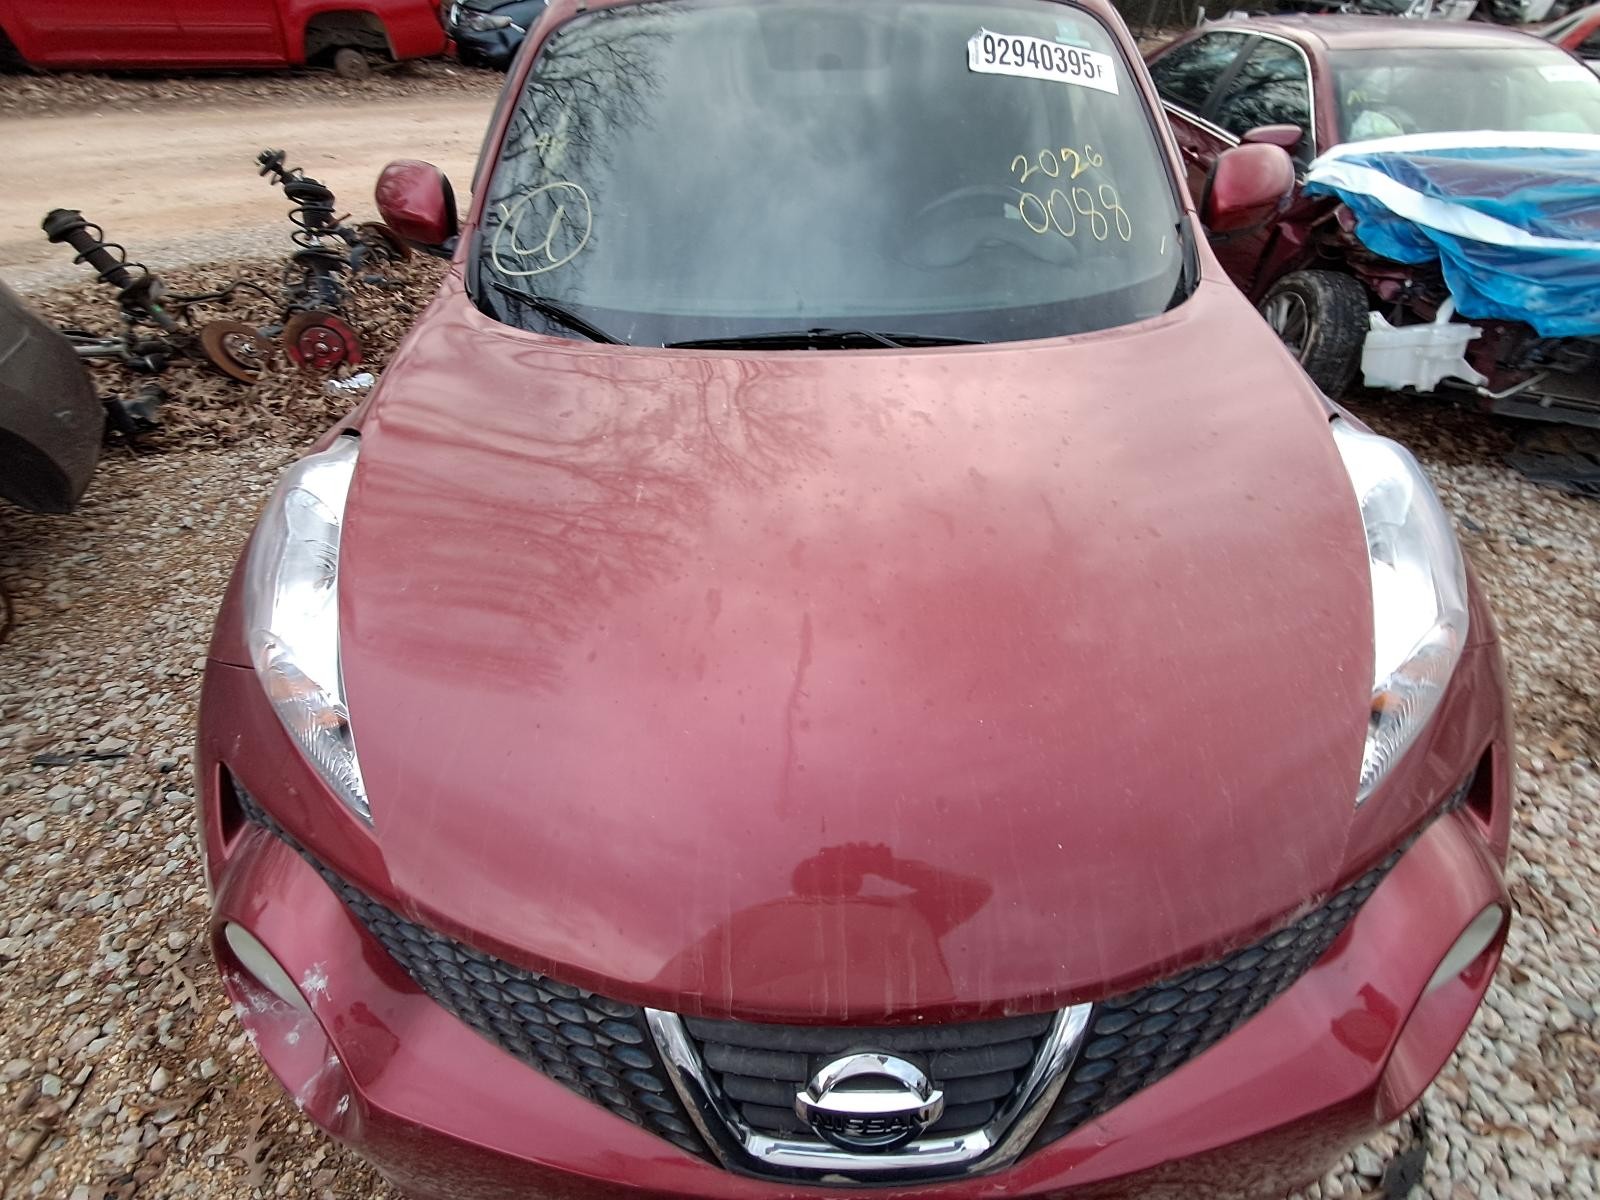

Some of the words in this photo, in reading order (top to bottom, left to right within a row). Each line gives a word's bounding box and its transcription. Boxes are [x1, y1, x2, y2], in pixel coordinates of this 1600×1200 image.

[1010, 144, 1103, 184] 2026
[1019, 184, 1132, 242] 0088
[809, 1108, 930, 1134] NISSAN
